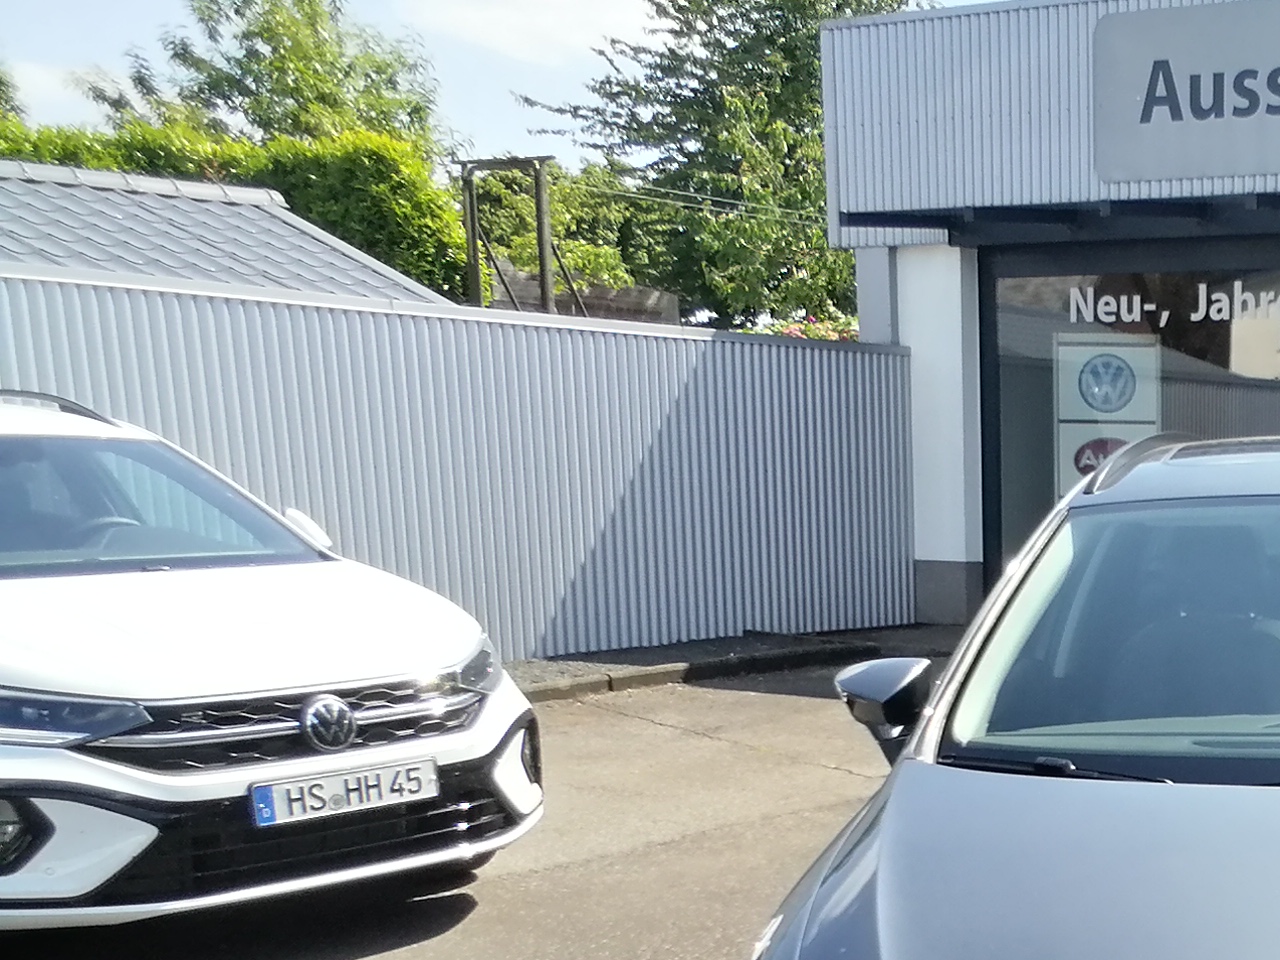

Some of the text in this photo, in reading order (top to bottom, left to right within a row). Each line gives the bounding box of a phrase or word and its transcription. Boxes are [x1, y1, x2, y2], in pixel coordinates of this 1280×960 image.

[1069, 284, 1169, 328] Neu-,
[286, 767, 422, 816] HS HH 45
